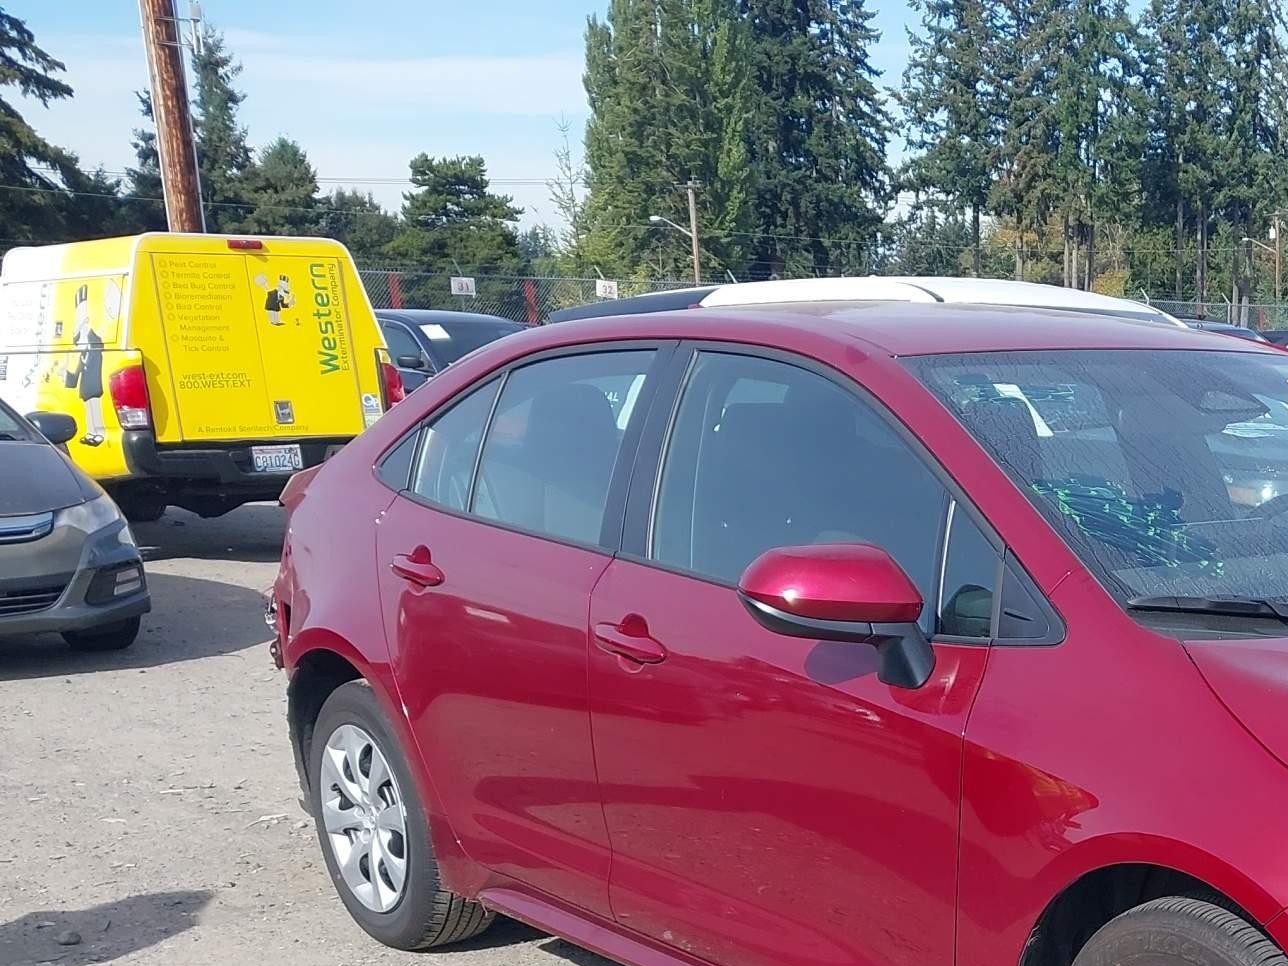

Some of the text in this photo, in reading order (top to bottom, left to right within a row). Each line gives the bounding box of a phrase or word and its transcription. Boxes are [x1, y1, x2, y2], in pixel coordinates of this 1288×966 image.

[188, 261, 217, 269] Control
[190, 283, 206, 291] Bug
[602, 284, 614, 295] 32
[178, 313, 220, 322] Vegetation
[310, 263, 341, 375] Western
[328, 263, 350, 371] Exterminator Company
[180, 324, 230, 333] Management
[181, 335, 217, 343] Mosquito
[274, 424, 309, 433] Company
